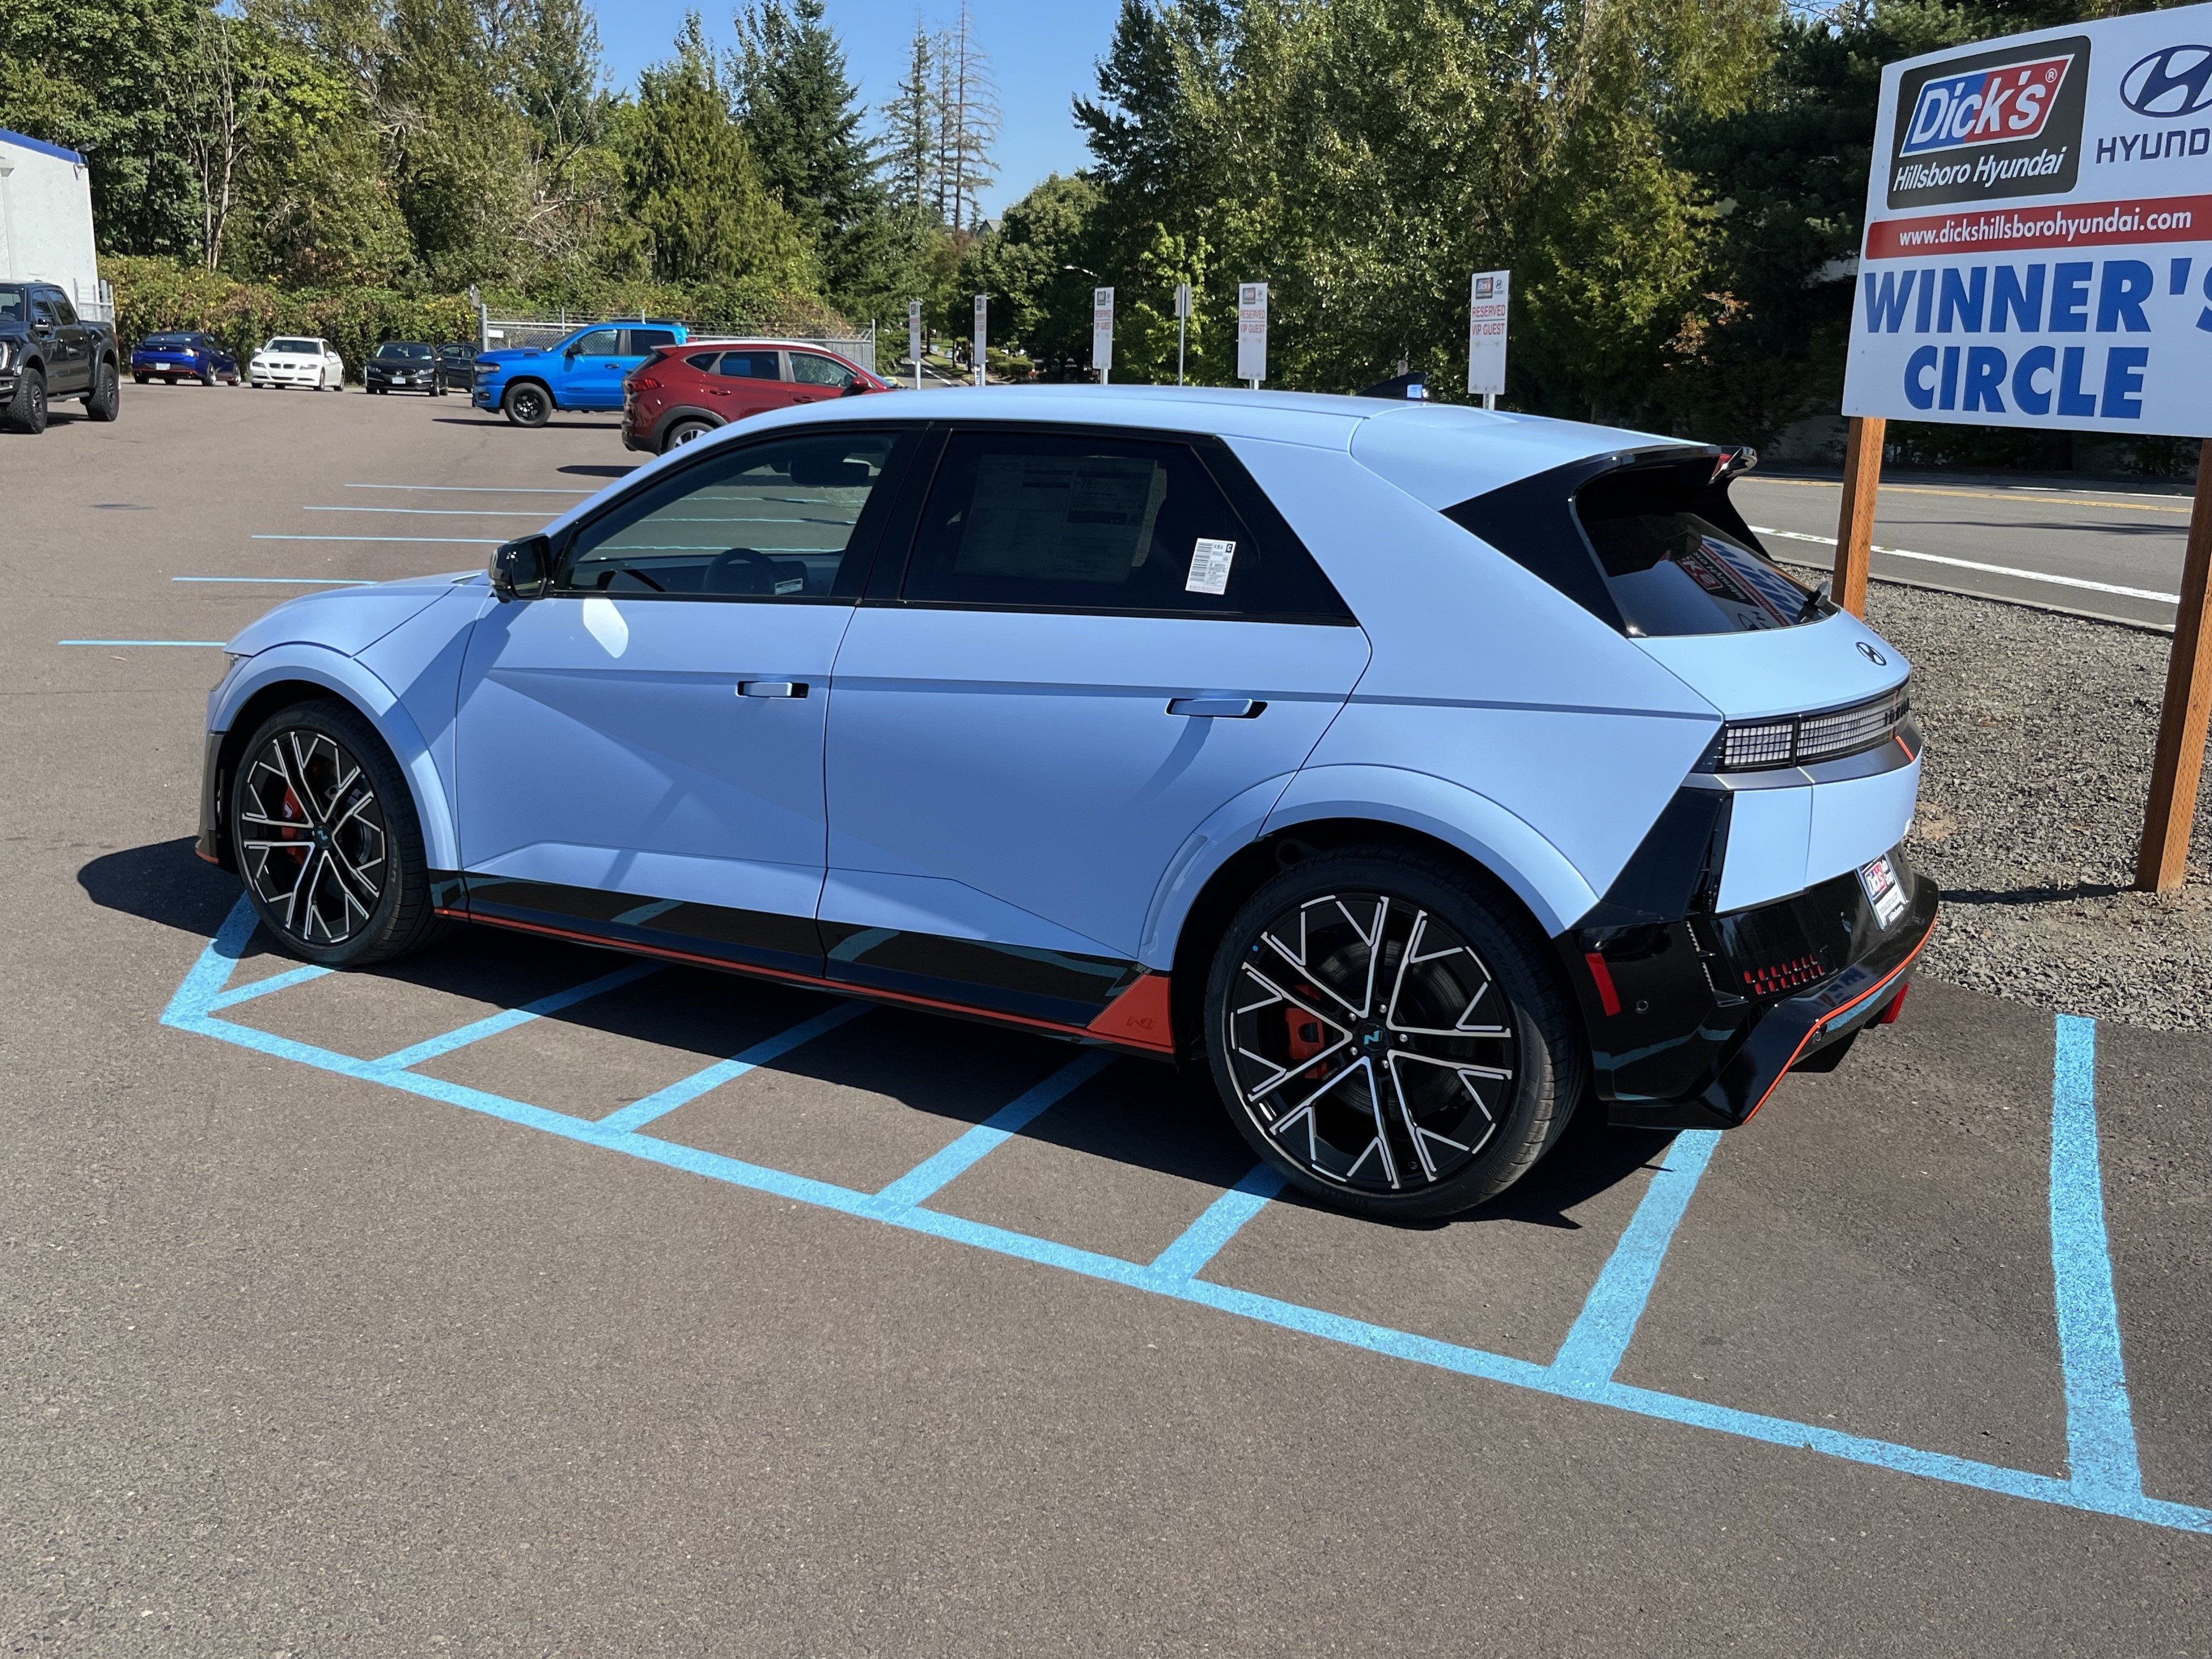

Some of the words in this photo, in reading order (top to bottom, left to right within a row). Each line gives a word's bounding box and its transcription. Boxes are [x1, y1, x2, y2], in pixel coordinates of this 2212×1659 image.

[1911, 71, 2046, 144] Dick's
[1893, 165, 1971, 191] Hillsboro
[1973, 146, 2067, 188] Hyundai
[1899, 206, 2191, 246] www.dickshillsborohyundai.com
[1240, 309, 1266, 319] RESERVED
[1472, 304, 1505, 318] RESERVED
[1249, 324, 1265, 334] GUEST
[1472, 324, 1481, 336] VIP
[1483, 323, 1505, 335] GUEST
[1904, 345, 2149, 419] CIRCLE
